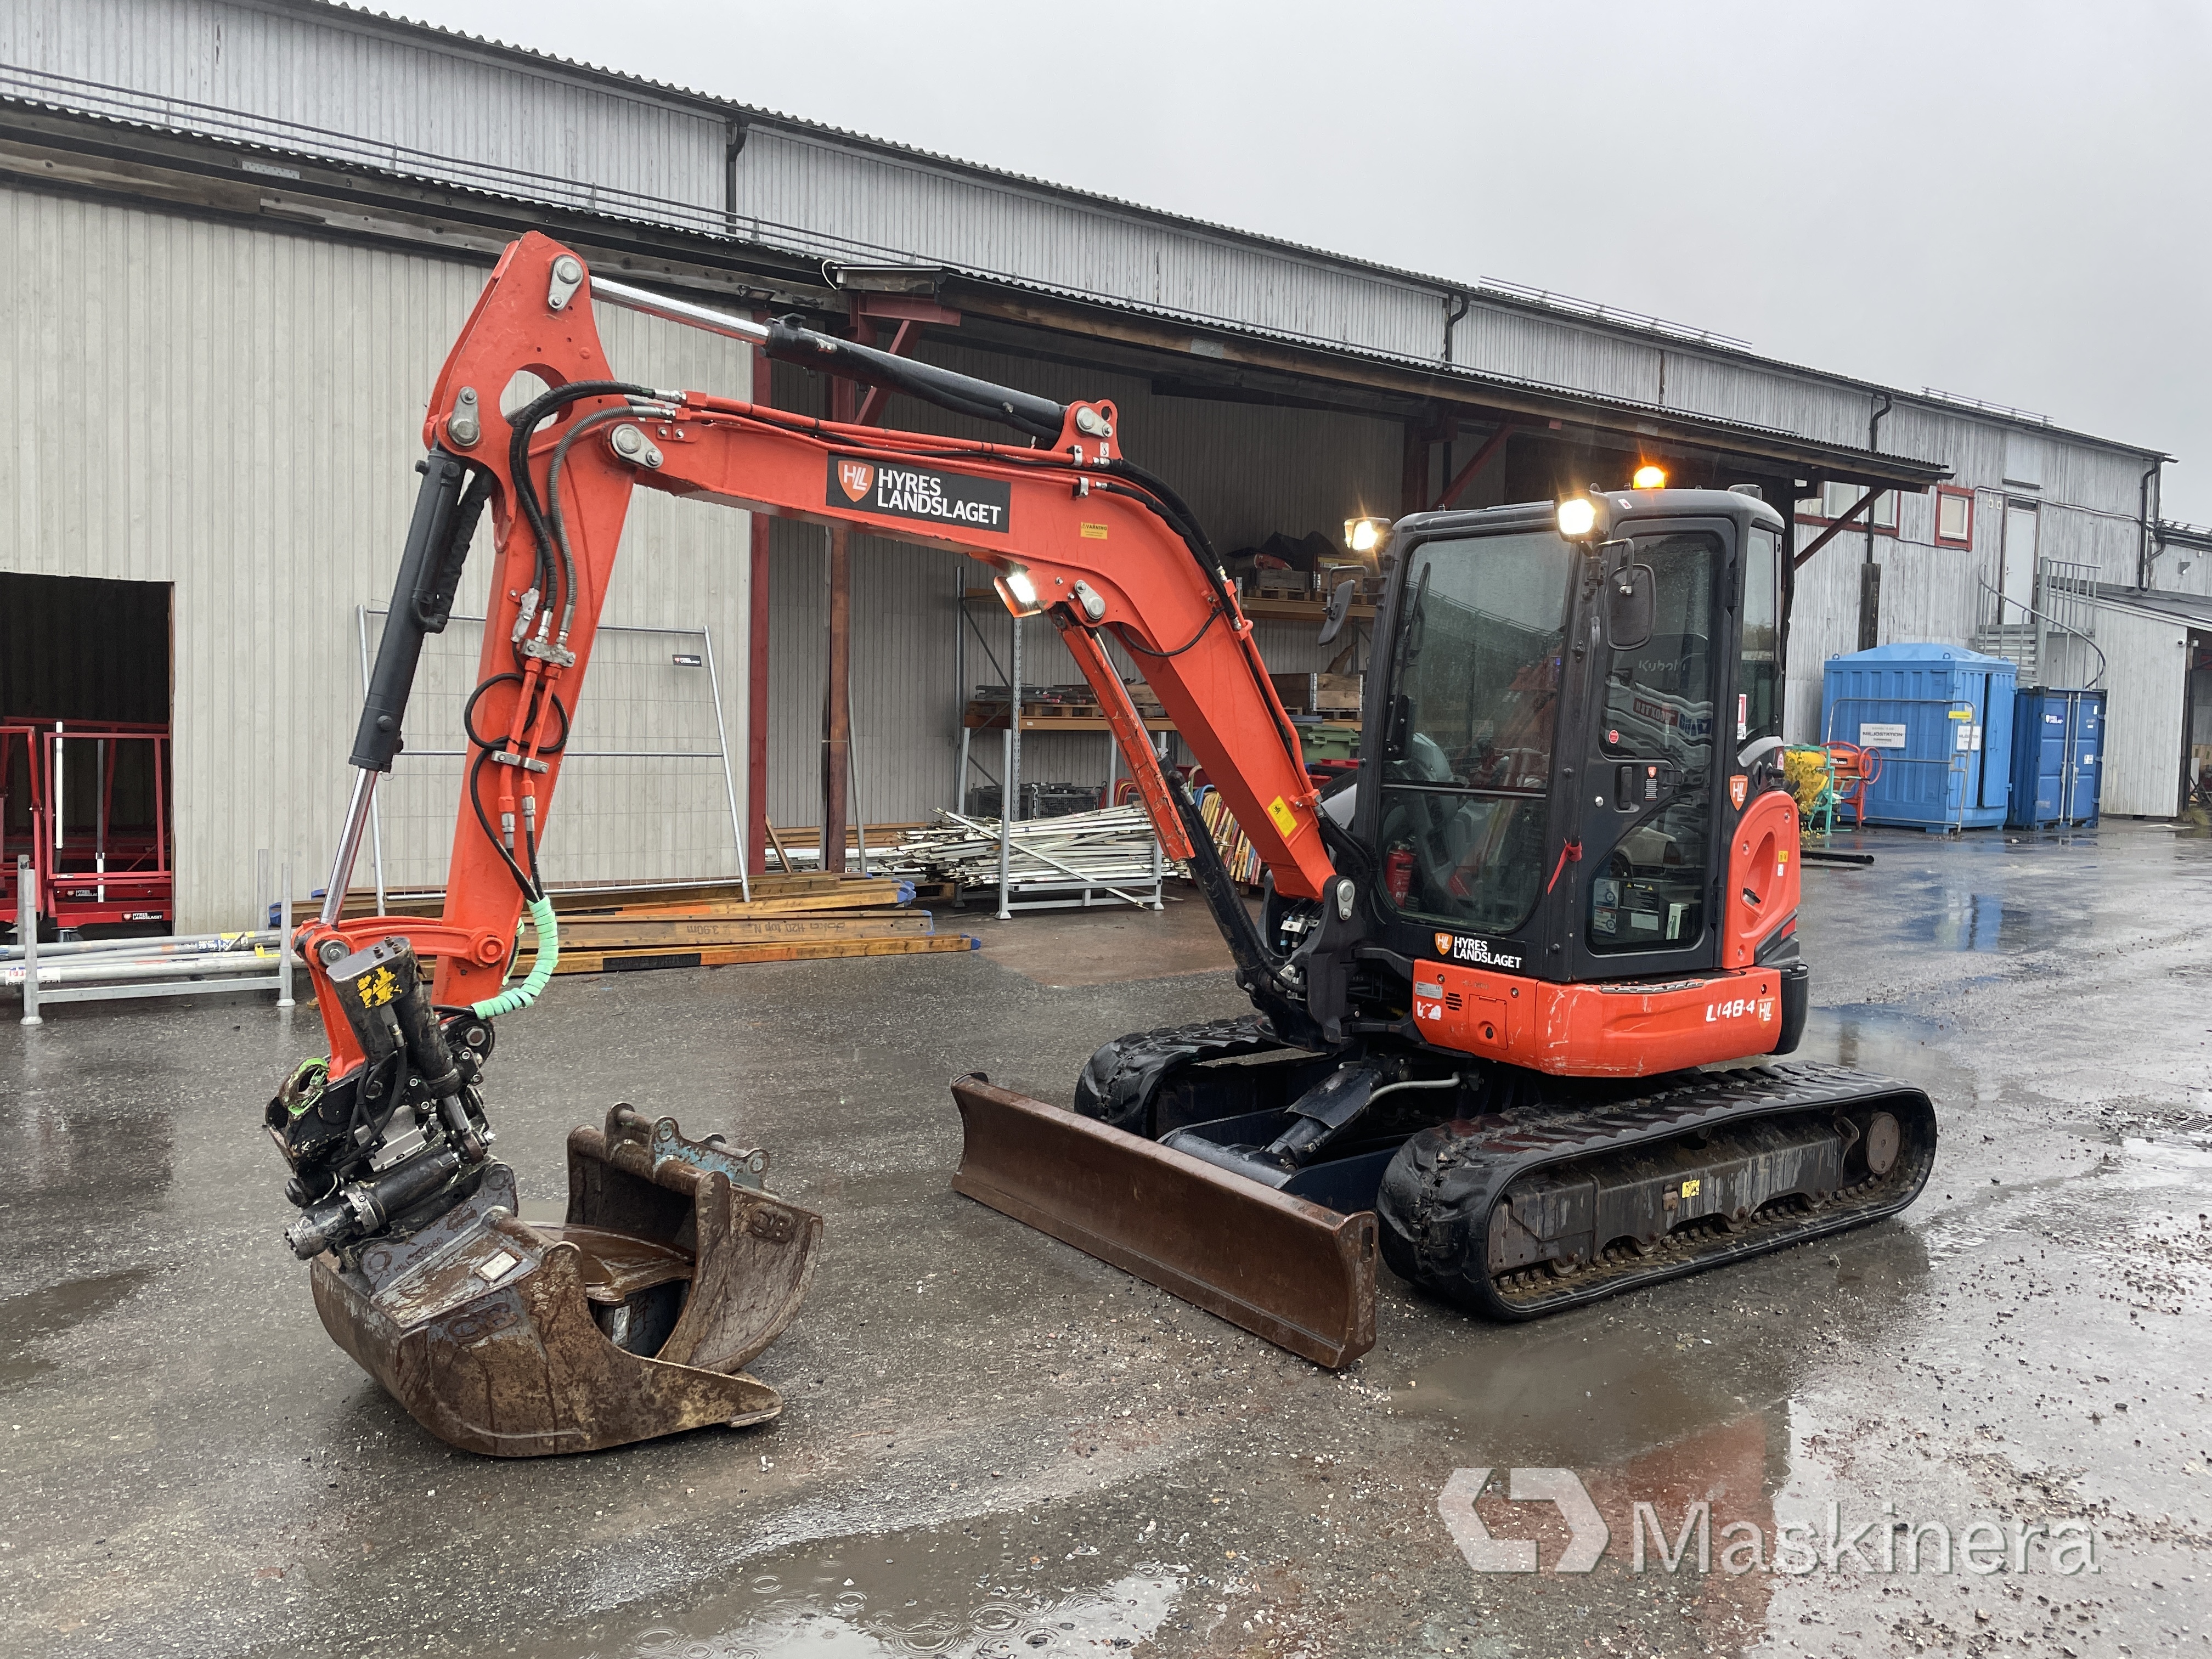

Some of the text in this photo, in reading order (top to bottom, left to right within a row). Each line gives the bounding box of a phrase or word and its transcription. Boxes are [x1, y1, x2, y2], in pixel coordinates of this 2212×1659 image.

[878, 467, 941, 496] HYRES
[877, 487, 1002, 525] LANDSLAGET
[1454, 936, 1488, 952] HYRES
[1453, 947, 1522, 969] LANDSLAGET
